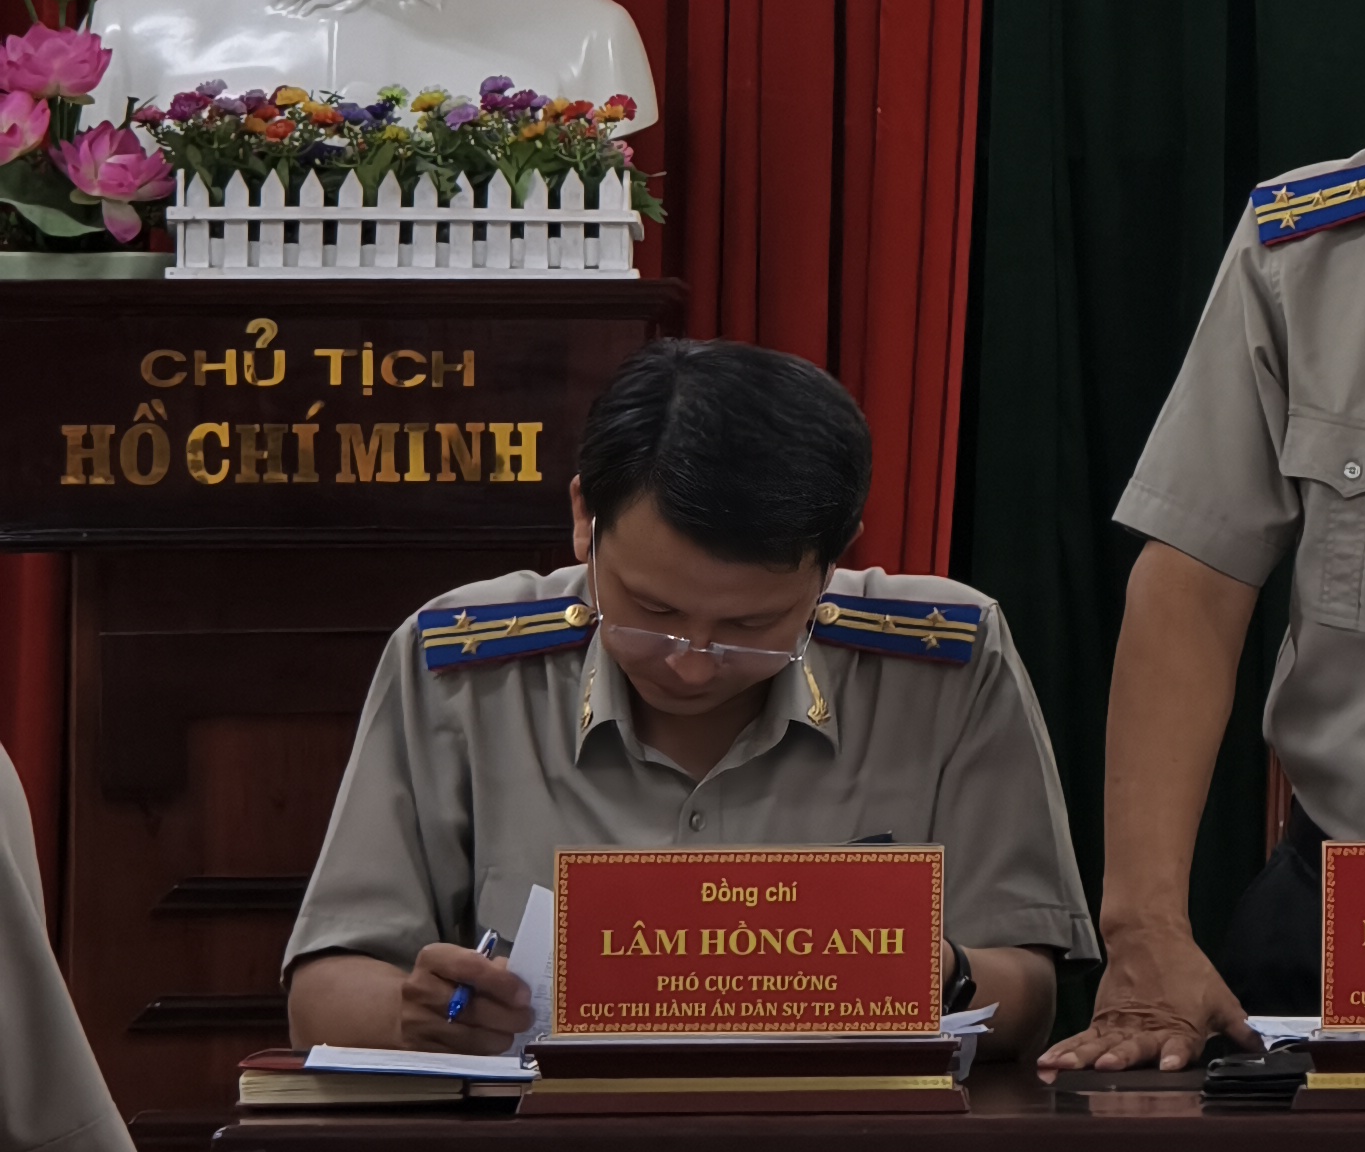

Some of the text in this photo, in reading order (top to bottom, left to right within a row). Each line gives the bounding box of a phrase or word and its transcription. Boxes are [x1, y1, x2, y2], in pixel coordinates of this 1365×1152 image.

[141, 318, 474, 395] CHỦ TỊCH
[60, 399, 542, 485] HỒ CHÍ MINH
[701, 877, 797, 906] Đồng chí
[600, 920, 689, 956] LÂM
[822, 928, 904, 955] ANH
[657, 970, 838, 995] PHÓ CỤC TRƯỞNG
[580, 1003, 614, 1021] CỤC
[618, 1003, 650, 1018] THI
[655, 998, 706, 1018] HÀNH
[710, 998, 736, 1018] ÁN
[741, 998, 777, 1017] DÂN
[811, 1002, 835, 1016] TP
[840, 998, 864, 1016] ĐÀ
